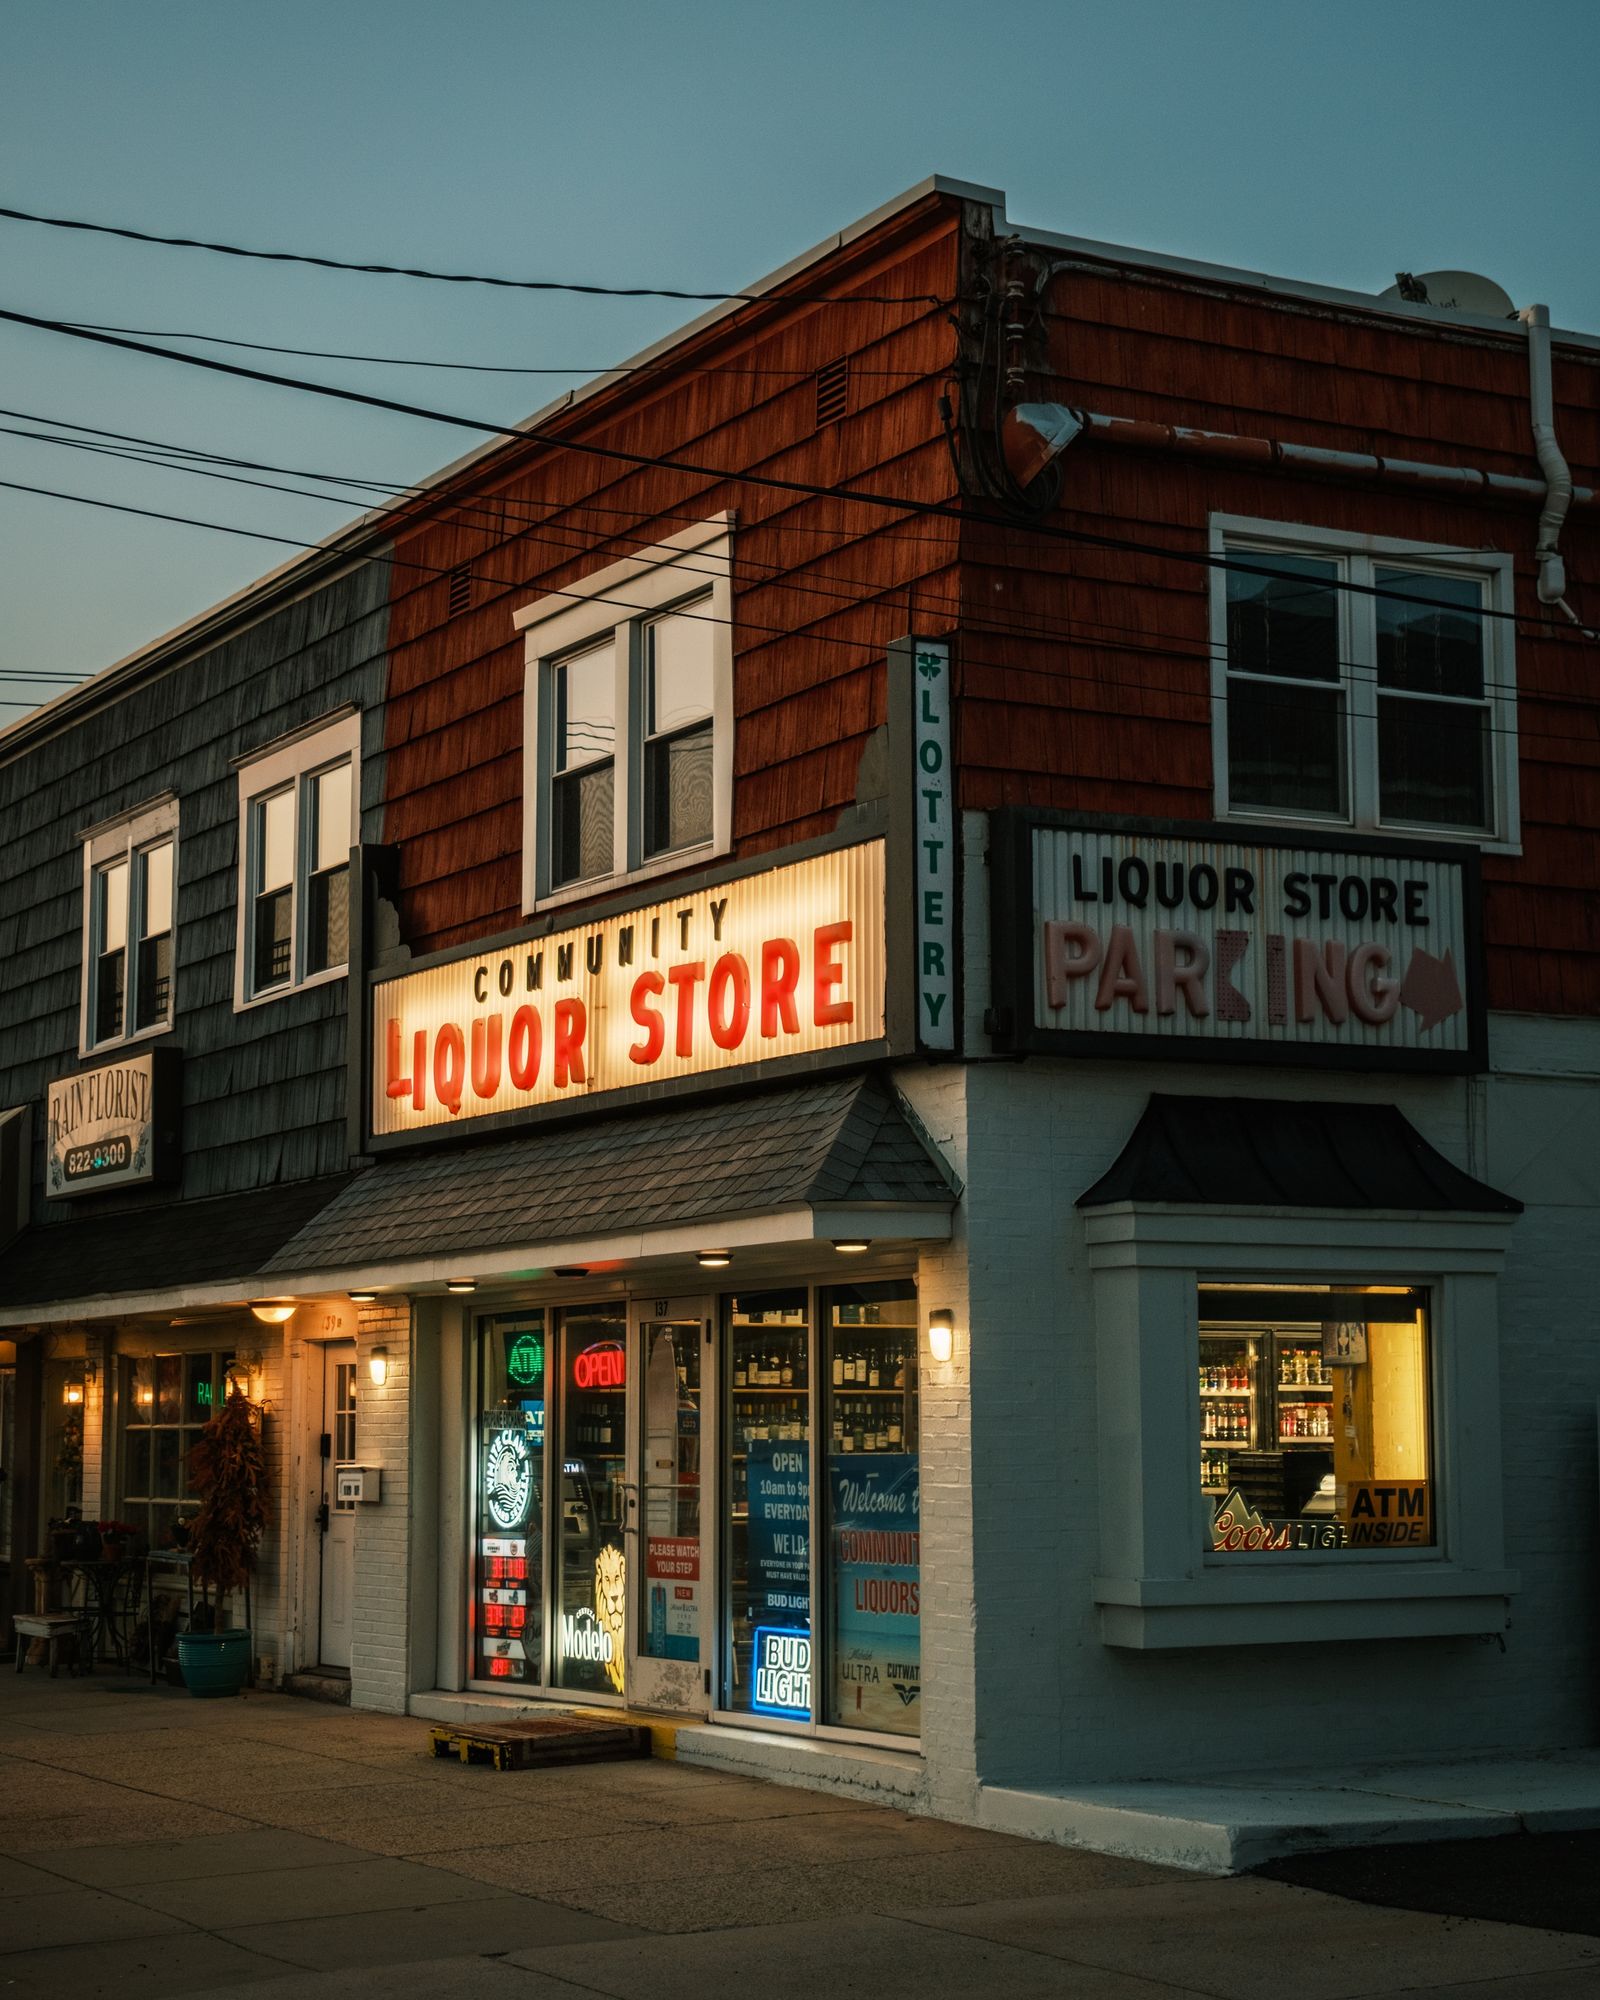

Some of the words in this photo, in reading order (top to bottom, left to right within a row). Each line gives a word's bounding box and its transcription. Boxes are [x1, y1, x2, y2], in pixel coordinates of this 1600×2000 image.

[919, 689, 947, 1028] LOTTERY
[1072, 854, 1256, 915] LIQUOR
[1283, 871, 1431, 927] STORE
[473, 897, 729, 1004] COMMUNITY
[1044, 918, 1402, 1026] PARKING
[386, 996, 587, 1115] LIQUOR
[628, 920, 855, 1066] STORE
[52, 1079, 85, 1145] RAIN
[87, 1069, 148, 1124] FLORIST
[68, 1142, 126, 1175] 822-9300
[655, 1301, 669, 1317] 137
[574, 1350, 625, 1389] OPEN
[525, 1409, 545, 1425] AT
[486, 1435, 503, 1495] WHITE
[501, 1429, 527, 1460] CLAW
[772, 1452, 803, 1473] OPEN
[760, 1479, 786, 1496] 10am
[786, 1480, 796, 1496] to
[797, 1480, 810, 1500] 9p
[839, 1478, 907, 1514] Welcome
[912, 1487, 920, 1515] t
[1351, 1487, 1424, 1519] ATM
[773, 1533, 790, 1555] WE
[1213, 1510, 1292, 1551] Coors
[1350, 1521, 1424, 1543] INSIDE
[649, 1543, 675, 1557] PLEASE
[675, 1545, 700, 1558] WATCH
[760, 1559, 786, 1569] EVERYONE
[840, 1529, 920, 1567] COMMUNIT
[656, 1560, 675, 1573] YOUR
[675, 1561, 694, 1575] STEP
[779, 1571, 793, 1580] HAVE
[767, 1593, 787, 1608] BUD
[788, 1595, 810, 1610] LIGH
[855, 1578, 920, 1617] LIQUORS
[576, 1607, 595, 1621] CERVEZA
[563, 1614, 613, 1664] Modelo
[765, 1634, 811, 1672] BUD
[842, 1663, 880, 1683] ULTRA
[887, 1662, 920, 1681] CUTWAT
